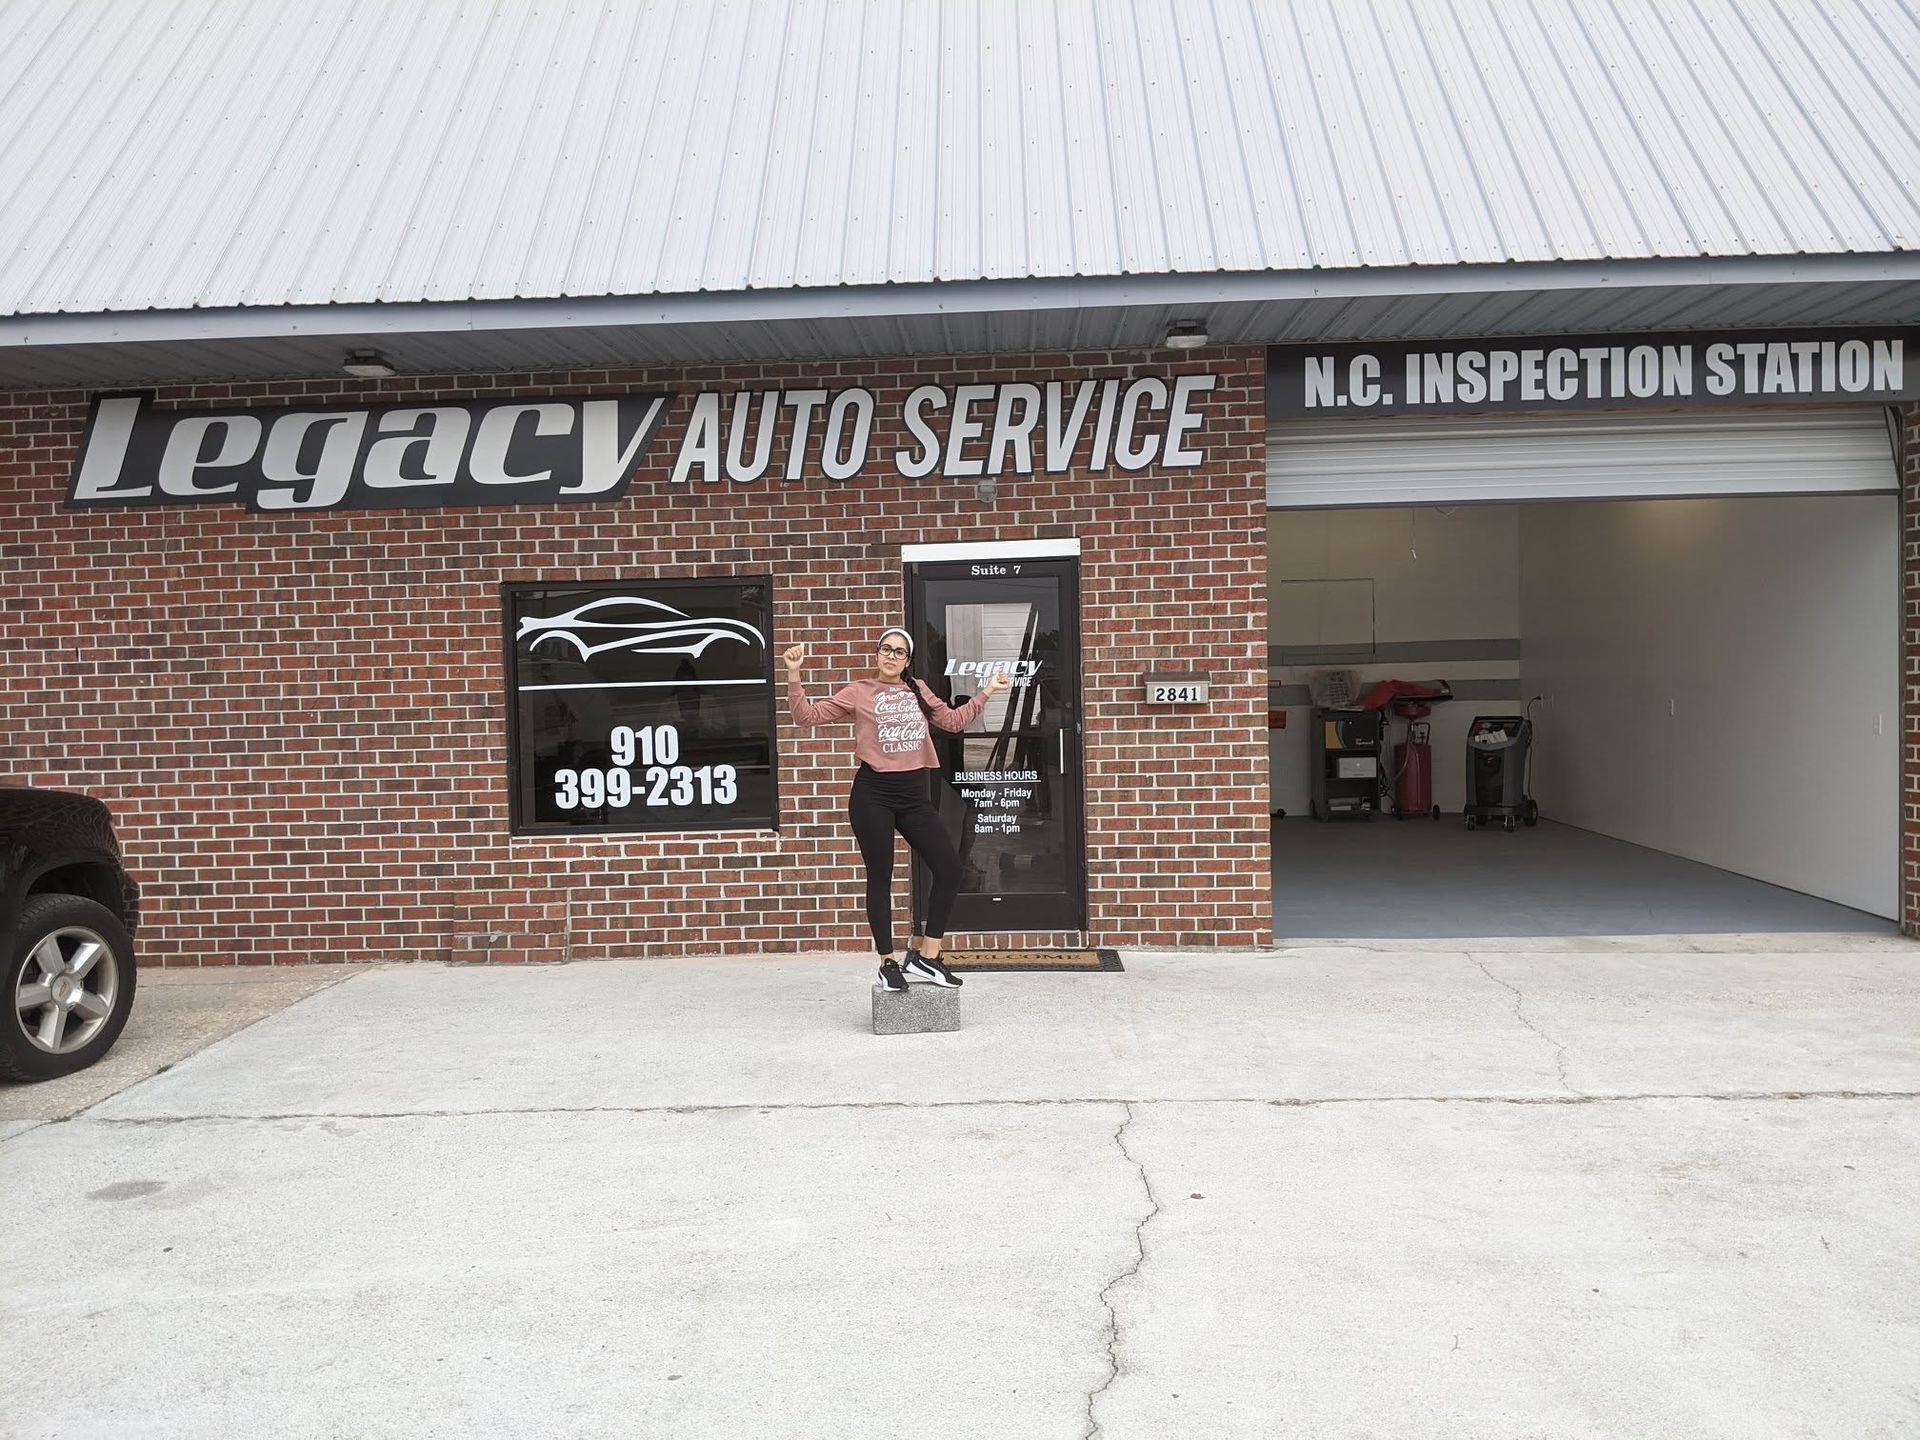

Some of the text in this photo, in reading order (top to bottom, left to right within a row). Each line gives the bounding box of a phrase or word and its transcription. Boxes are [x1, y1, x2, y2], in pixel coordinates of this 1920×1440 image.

[1303, 338, 1905, 408] N.C. INSPECTION STATION
[73, 374, 1217, 510] Legacy AUTO SERVICE
[971, 564, 1022, 576] Suite 7
[944, 658, 1044, 678] Legacy
[1155, 687, 1198, 702] 2841
[610, 724, 679, 767] 910
[882, 740, 922, 753] CLASSIC
[954, 770, 1038, 781] BUSINESS HOURS
[554, 764, 738, 810] 399-2313
[961, 788, 996, 799] Monday
[1004, 787, 1032, 799] Friday
[973, 799, 993, 808] 7am
[1000, 798, 1020, 809] 6pm
[977, 813, 1017, 824] Saturday
[974, 824, 993, 833] 8am
[1001, 823, 1020, 834] 1pm
[951, 953, 1081, 961] WELCOME
